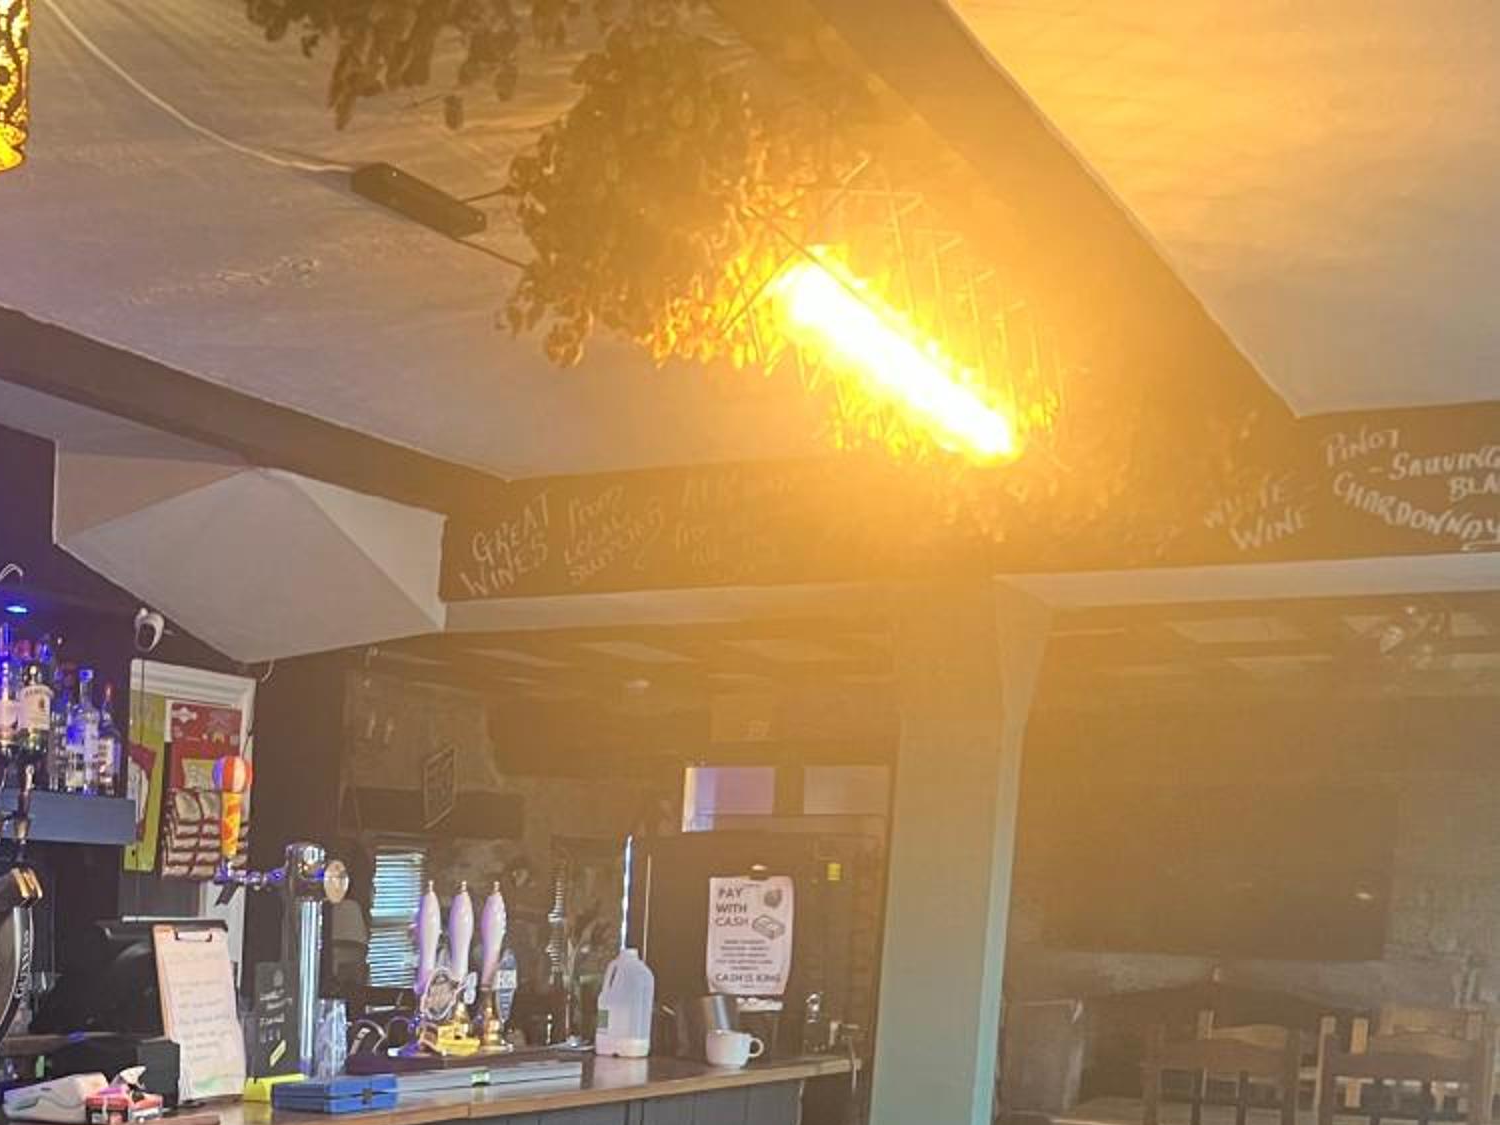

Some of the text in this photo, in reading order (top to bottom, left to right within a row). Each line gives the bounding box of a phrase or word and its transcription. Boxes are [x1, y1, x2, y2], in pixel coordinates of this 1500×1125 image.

[1325, 429, 1399, 467] PINOT
[472, 491, 549, 566] GREAT
[460, 533, 549, 596] WINES
[718, 887, 743, 898] PAY
[716, 903, 747, 913] WITH
[715, 917, 748, 927] CASH
